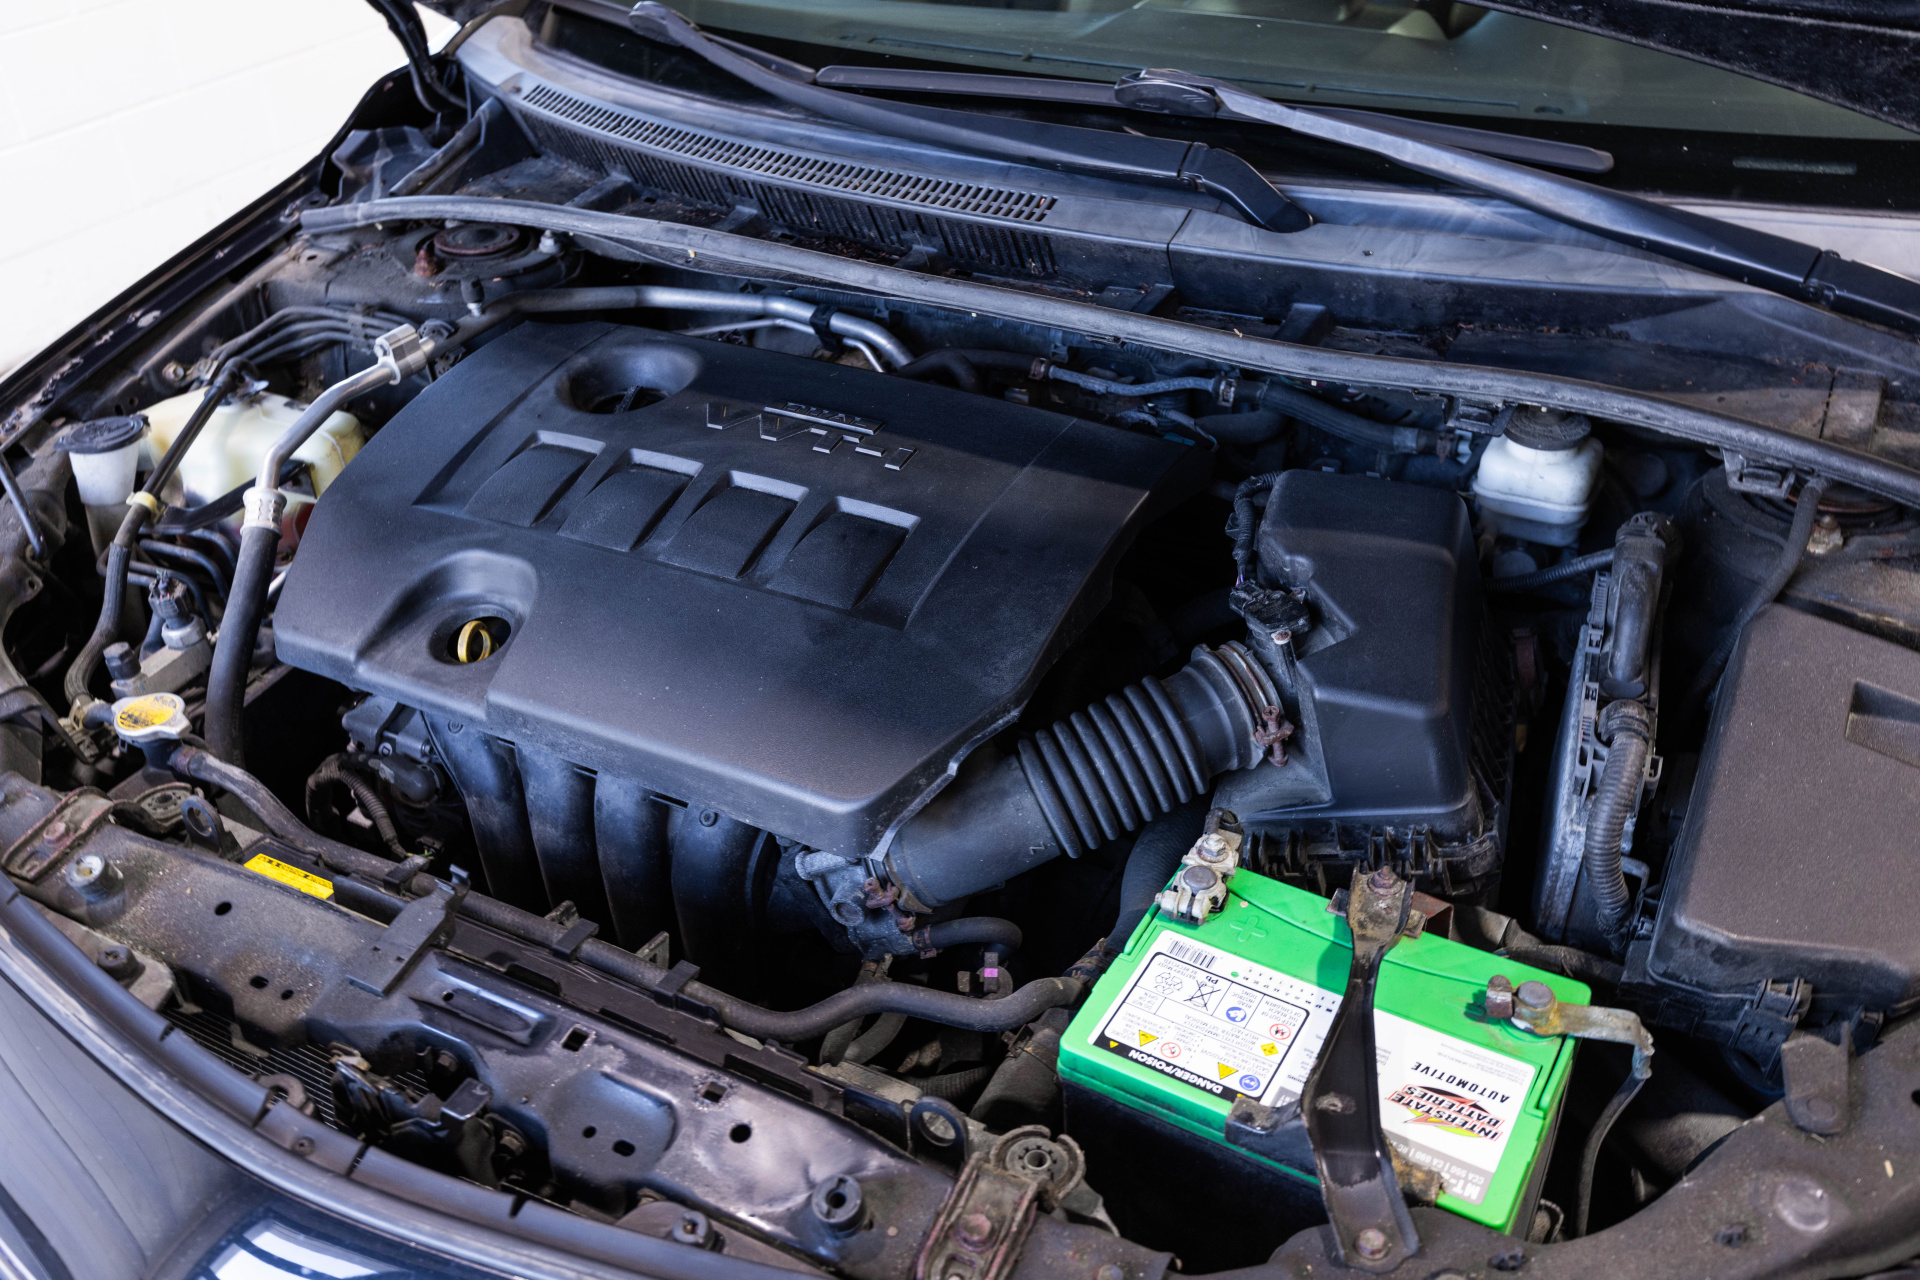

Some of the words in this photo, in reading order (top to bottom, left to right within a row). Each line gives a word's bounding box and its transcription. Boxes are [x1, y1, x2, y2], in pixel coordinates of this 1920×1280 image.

[1203, 974, 1219, 984] Pb
[1127, 1048, 1224, 1094] DANGER/POISON
[1410, 1060, 1510, 1105] AUTOMOTIVE
[1390, 1092, 1498, 1141] INTERSTATE
[1403, 1084, 1500, 1129] BATTERIES
[1430, 1156, 1444, 1169] CA
[1466, 1171, 1485, 1185] CCA
